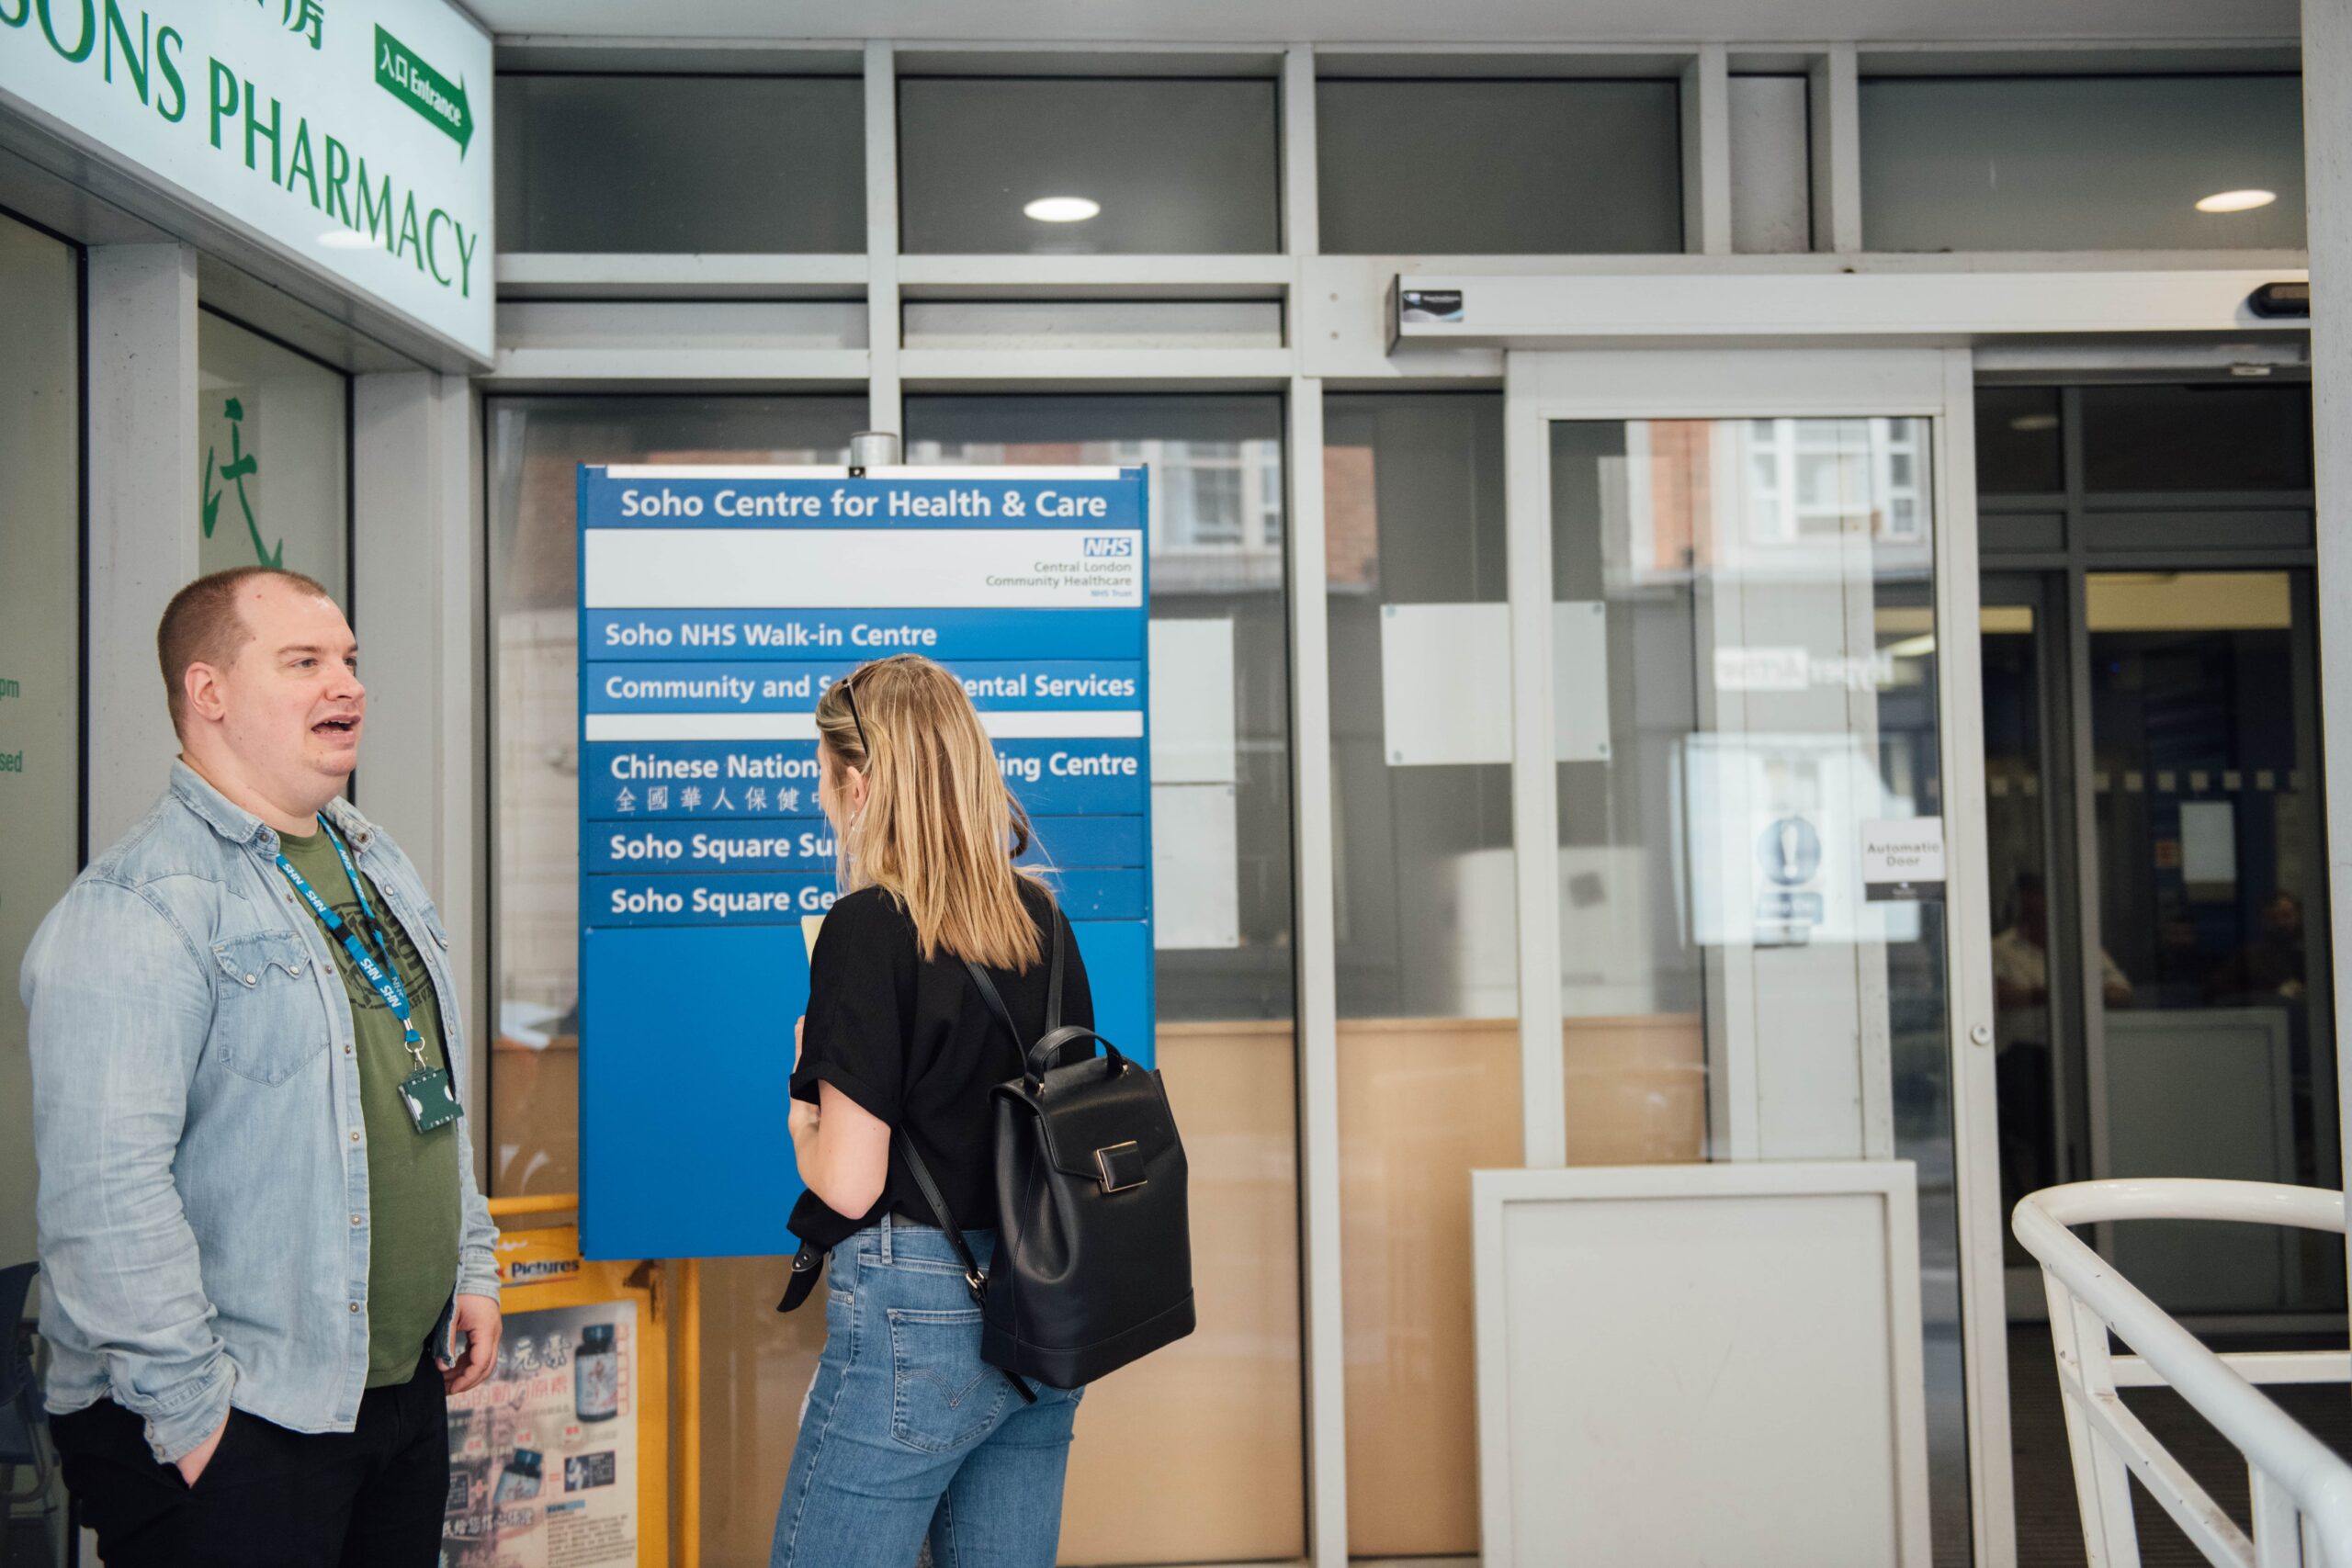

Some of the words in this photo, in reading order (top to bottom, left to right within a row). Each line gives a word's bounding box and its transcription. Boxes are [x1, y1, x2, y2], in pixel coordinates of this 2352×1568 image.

[379, 42, 409, 88] 入口
[410, 66, 462, 128] Entrance
[209, 55, 478, 299] PHARMACY
[621, 488, 704, 518] Soho
[714, 490, 821, 518] Centre
[831, 489, 879, 517] for
[888, 489, 991, 517] Health
[1001, 491, 1026, 517] &
[1035, 491, 1108, 517] Care
[1084, 537, 1132, 557] NHS
[1034, 561, 1080, 573] Central
[1084, 561, 1132, 573] London
[986, 575, 1059, 589] Community
[1064, 575, 1132, 587] Healthcare
[605, 623, 673, 646] Soho
[681, 624, 737, 646] NHS
[743, 623, 842, 647] Walk-in
[851, 624, 937, 646] Centre
[605, 674, 755, 704] Community
[763, 674, 810, 698] and
[958, 673, 1027, 697] ental
[1035, 673, 1136, 697] Services
[611, 753, 718, 779] Chinese
[727, 754, 822, 779] Nation
[997, 752, 1041, 782] ing
[1048, 751, 1138, 775] Centre
[610, 834, 684, 860] Soho
[692, 834, 790, 863] Square
[1867, 841, 1940, 854] Automatic
[1886, 855, 1921, 867] Door
[282, 863, 304, 886] NHS
[305, 890, 327, 912] NHS
[611, 887, 684, 913] Soho
[692, 887, 790, 918] Square
[798, 886, 840, 911] Ge
[359, 957, 382, 981] NHS
[379, 985, 402, 1009] NHS
[511, 1259, 580, 1278] Pictures
